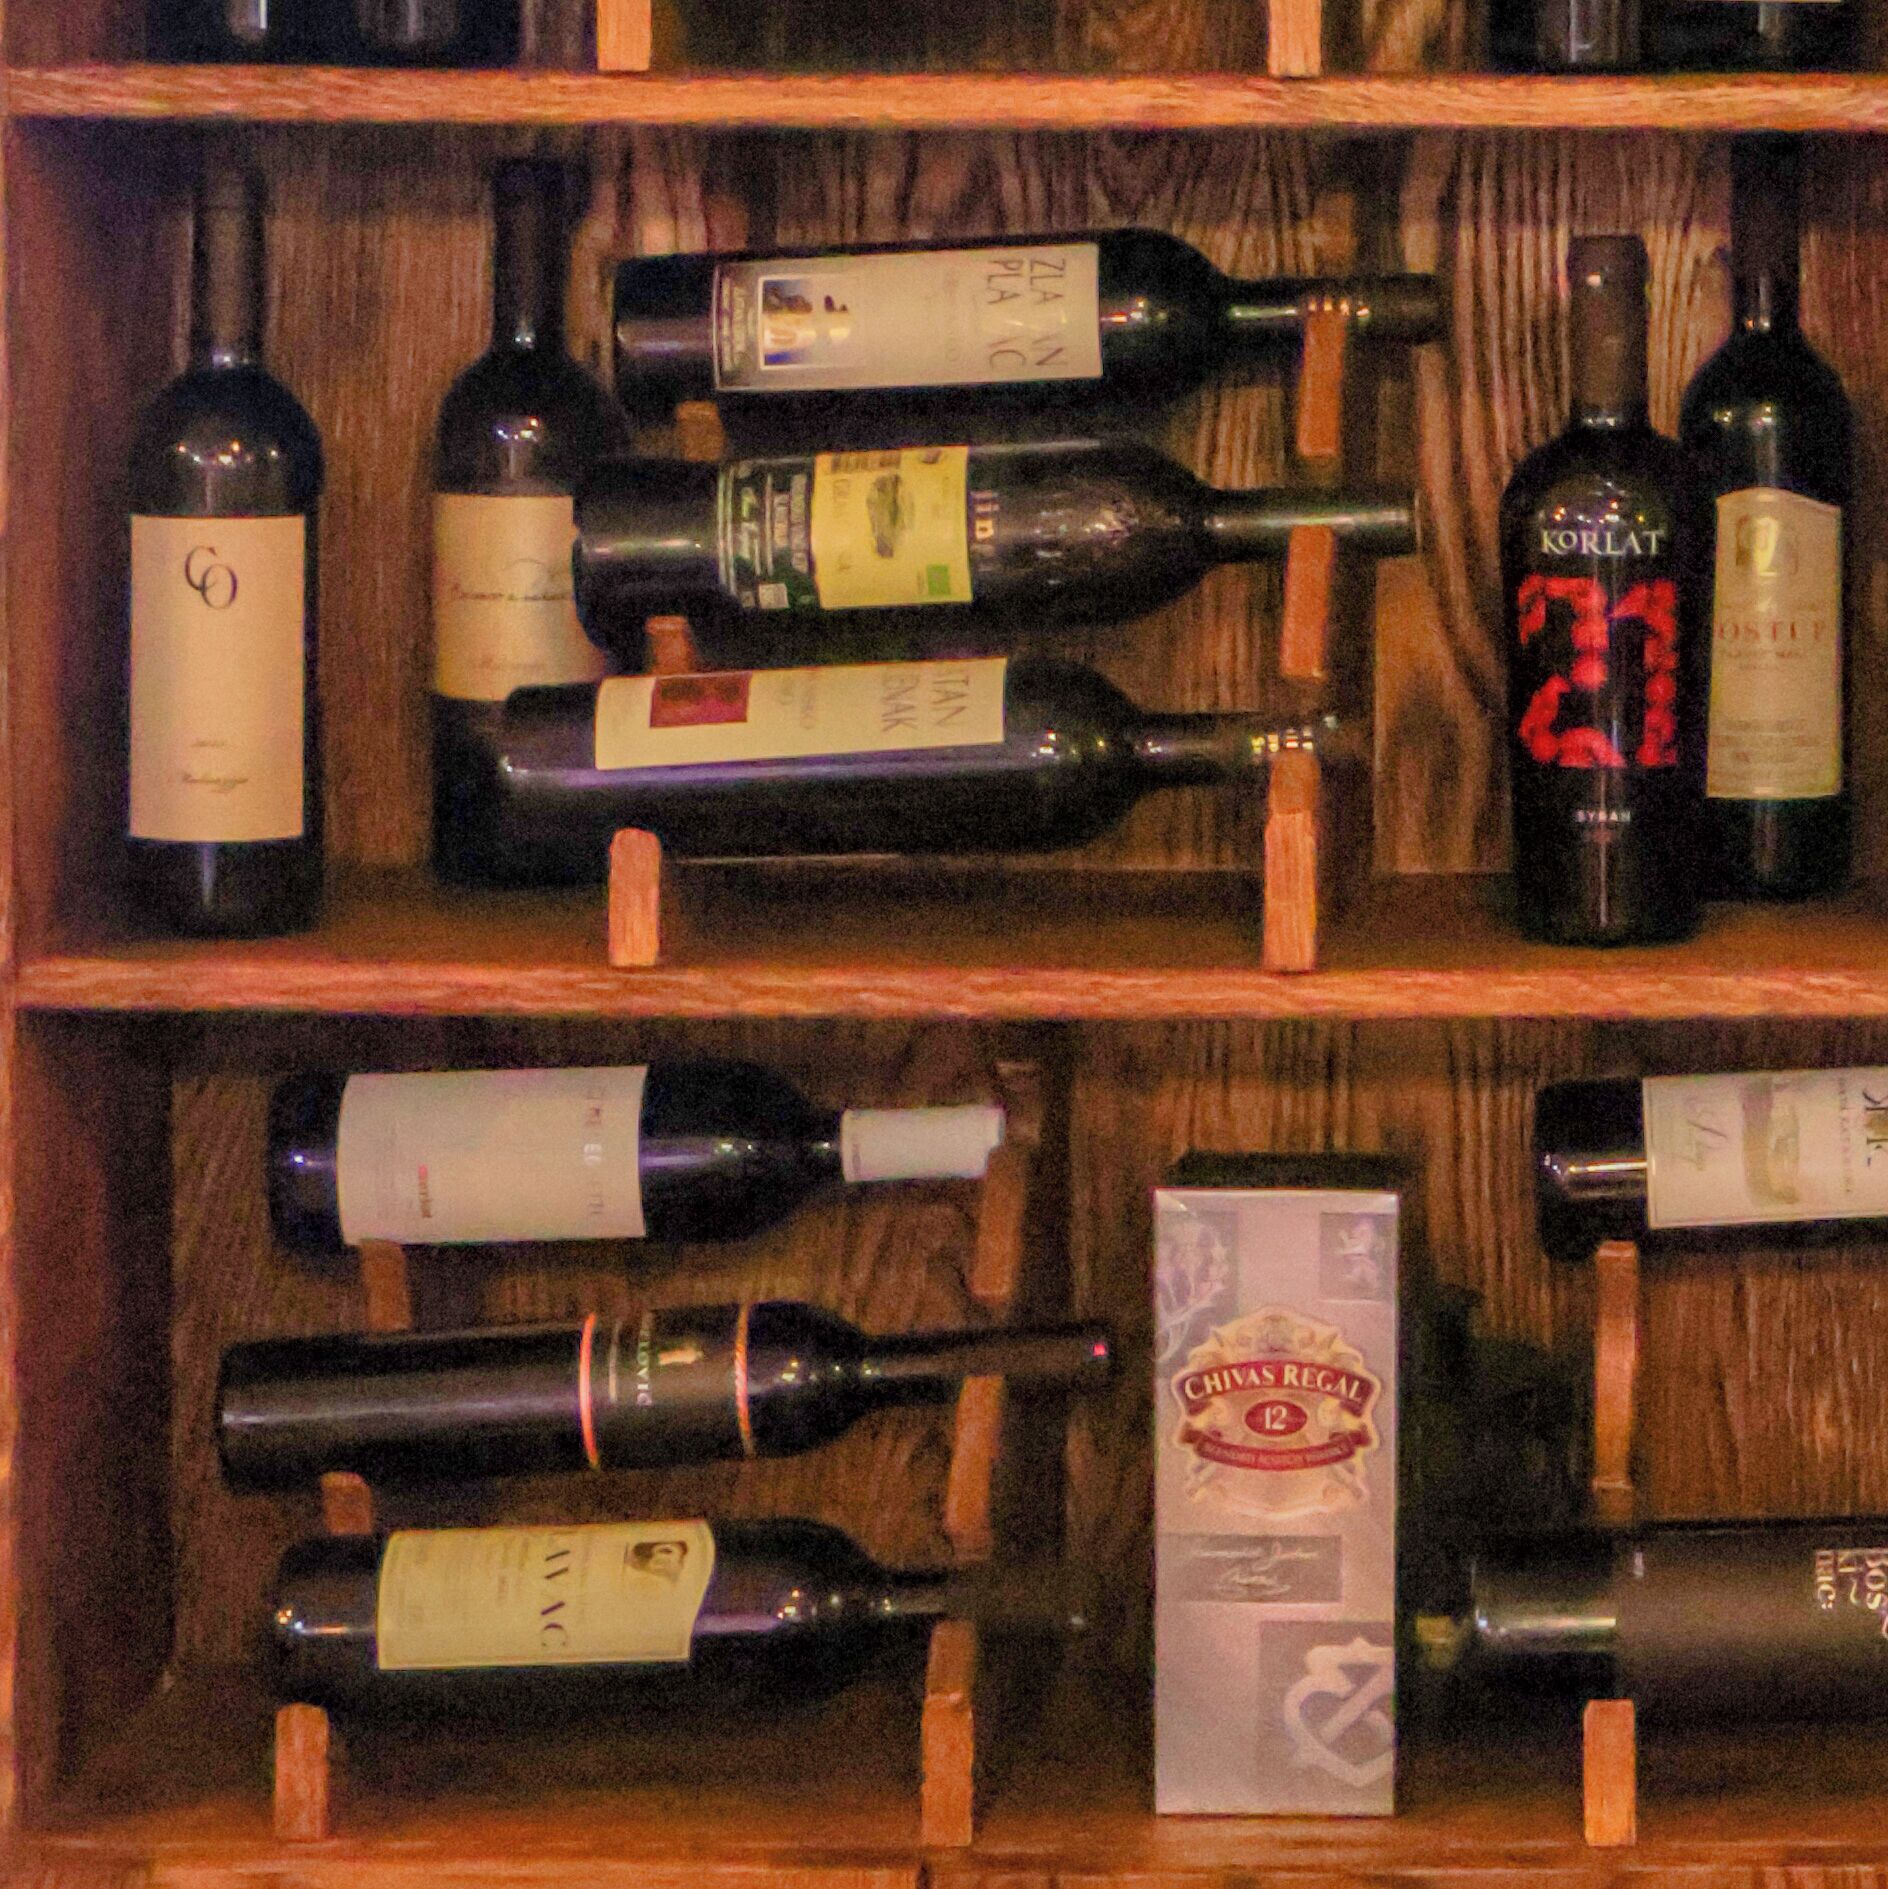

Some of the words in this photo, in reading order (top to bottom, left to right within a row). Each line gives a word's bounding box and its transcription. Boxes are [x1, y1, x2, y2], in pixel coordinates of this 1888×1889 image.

[1541, 529, 1664, 555] KORLAT
[1184, 1364, 1276, 1401] CHIVAS
[1282, 1363, 1364, 1403] REGAL
[1264, 1404, 1289, 1431] 12
